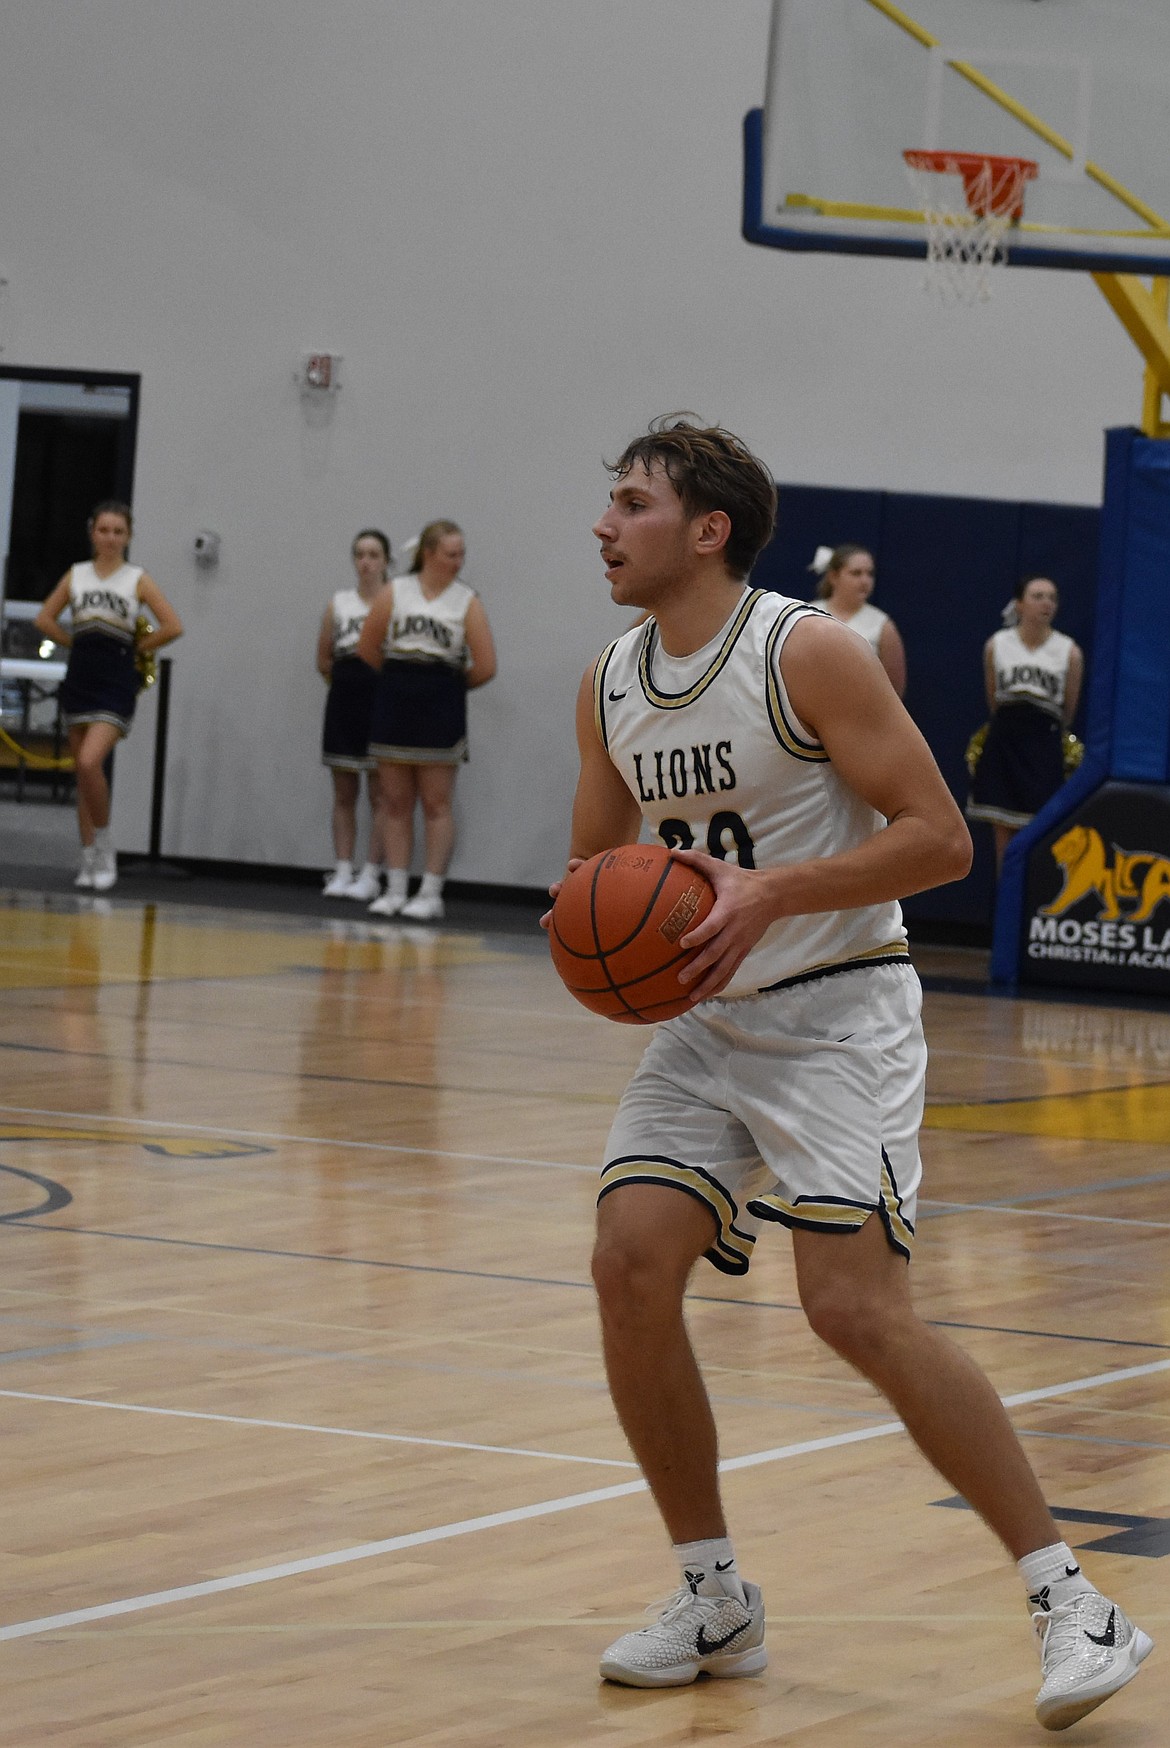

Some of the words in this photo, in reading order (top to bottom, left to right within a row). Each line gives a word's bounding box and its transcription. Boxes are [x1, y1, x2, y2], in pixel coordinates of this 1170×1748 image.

[69, 590, 129, 618] LIONS
[393, 614, 453, 648] LIONS
[998, 664, 1060, 697] LIONS
[633, 741, 736, 802] LIONS
[1030, 917, 1135, 949] MOSES
